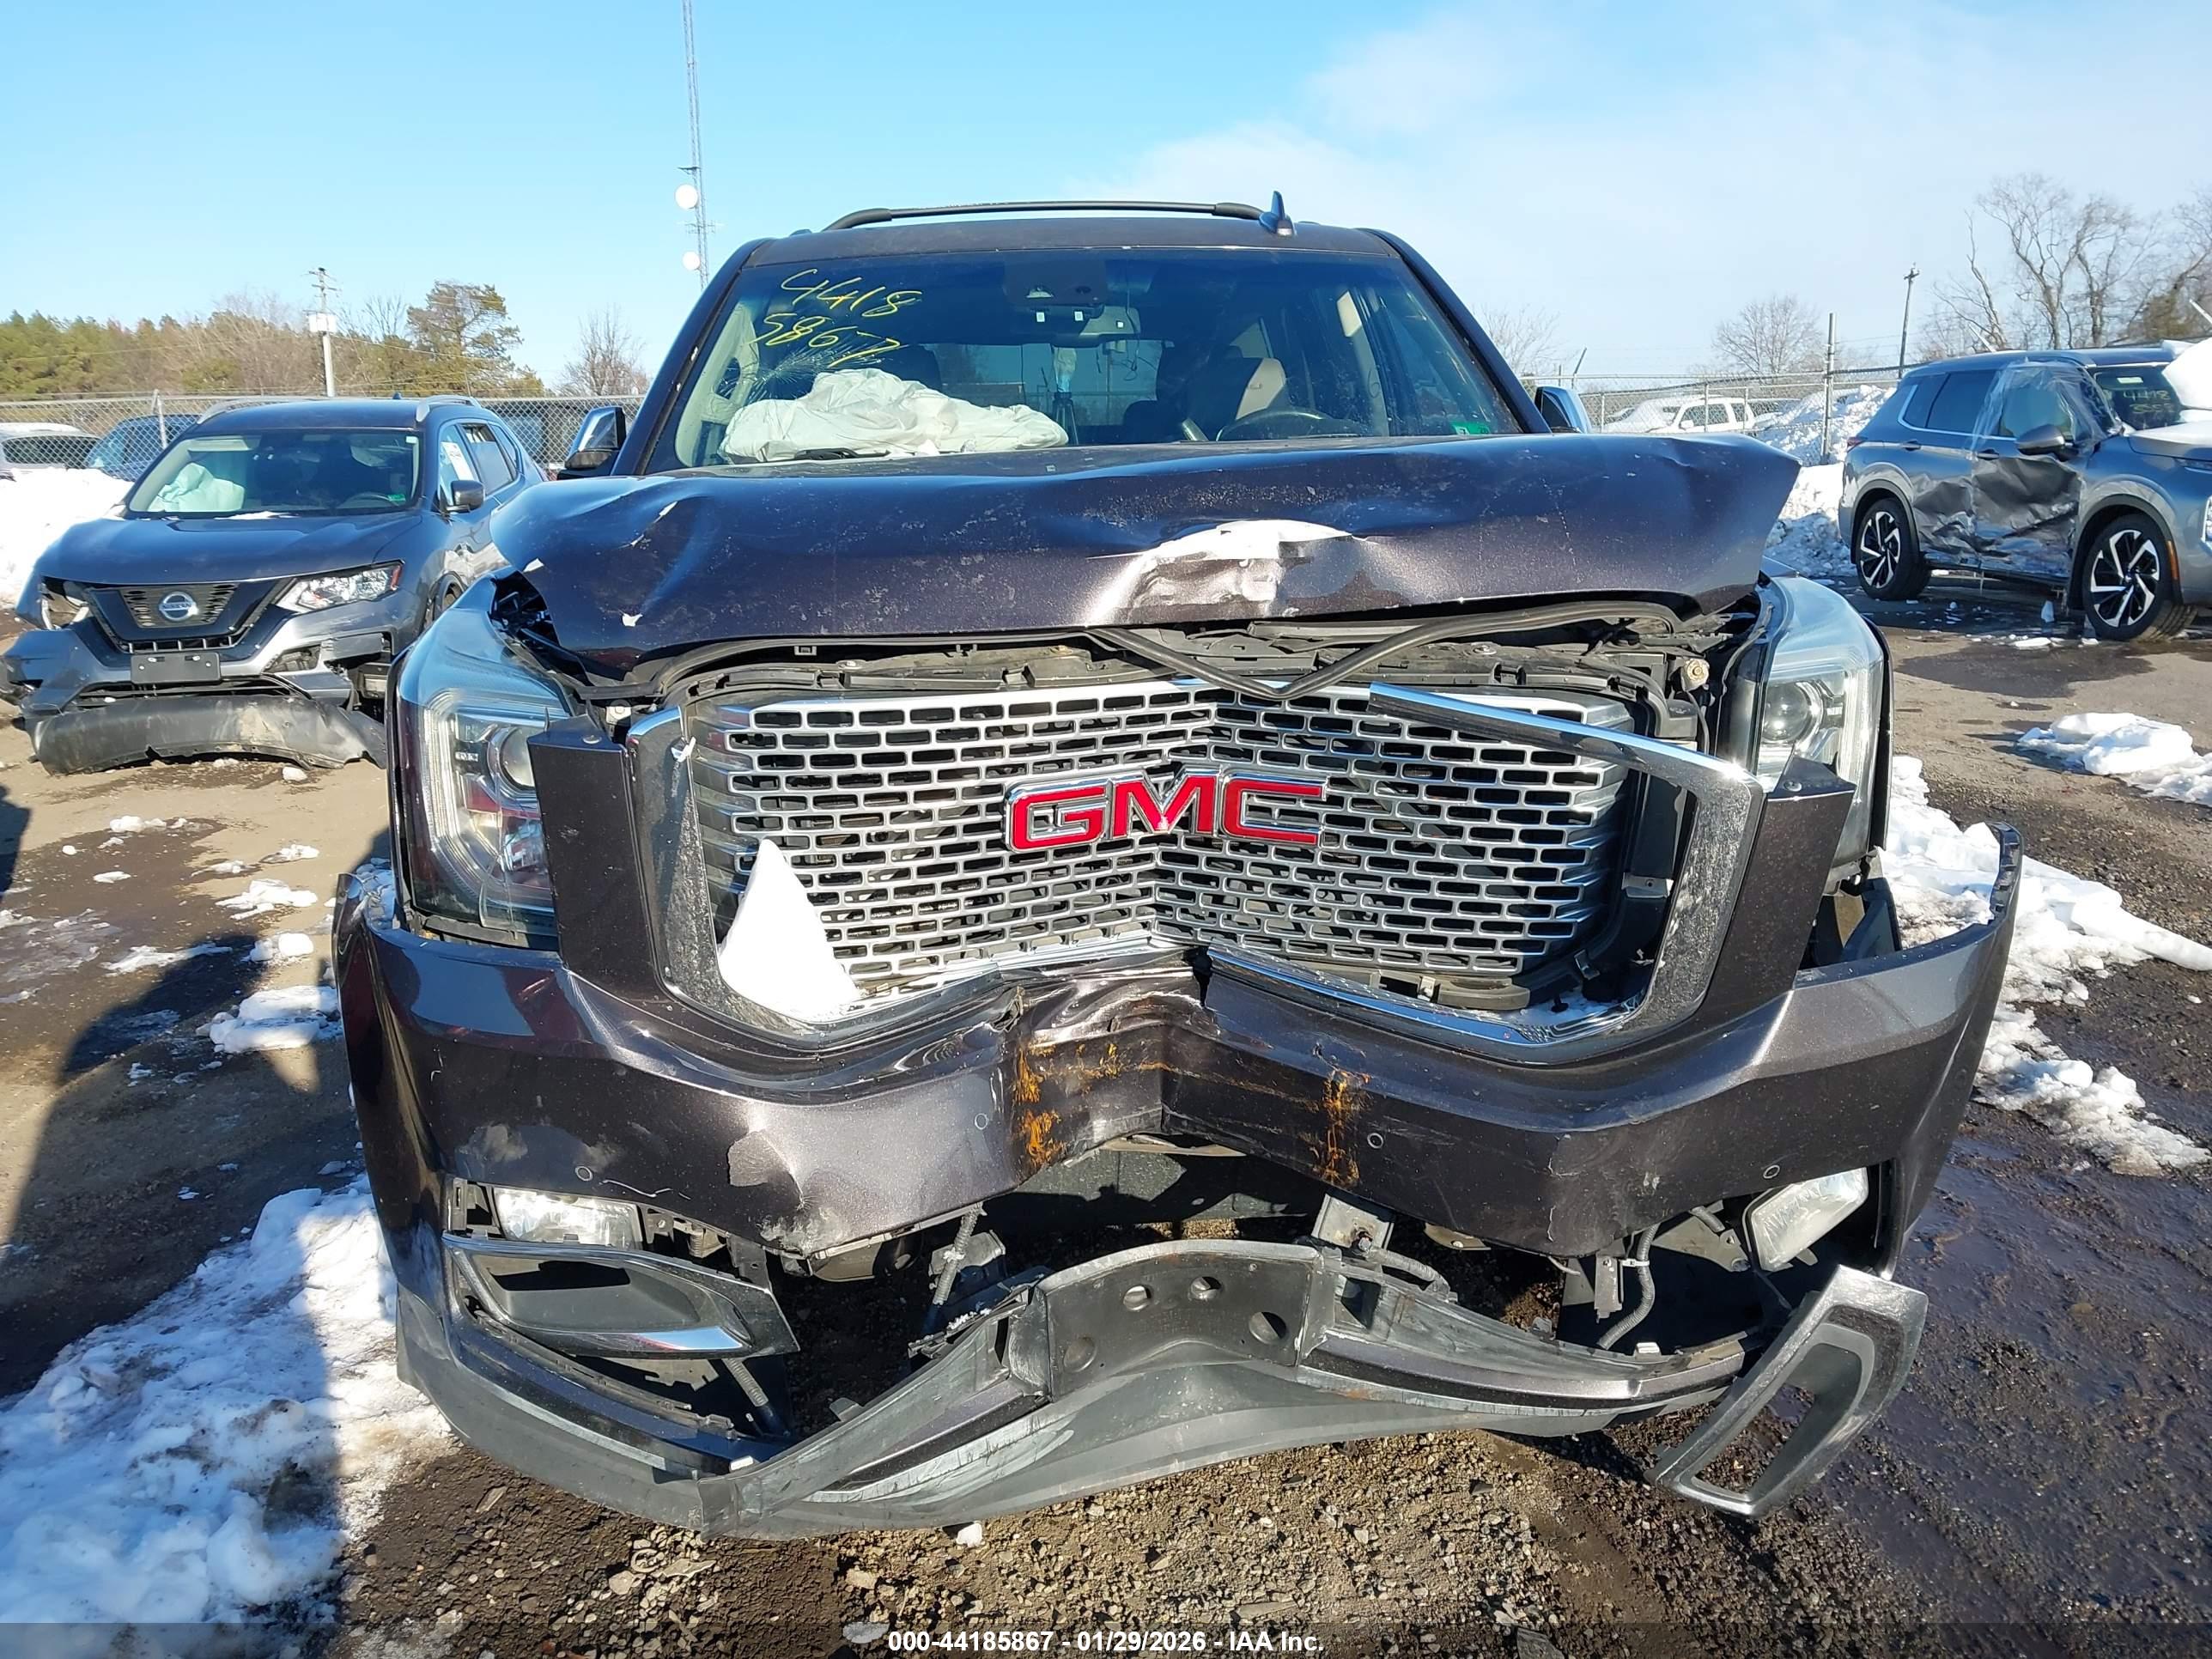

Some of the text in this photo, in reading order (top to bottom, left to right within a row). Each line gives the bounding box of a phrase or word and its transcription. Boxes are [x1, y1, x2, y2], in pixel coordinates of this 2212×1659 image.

[781, 268, 922, 318] 4418
[749, 313, 902, 368] 5867
[1005, 766, 1328, 852] GMC
